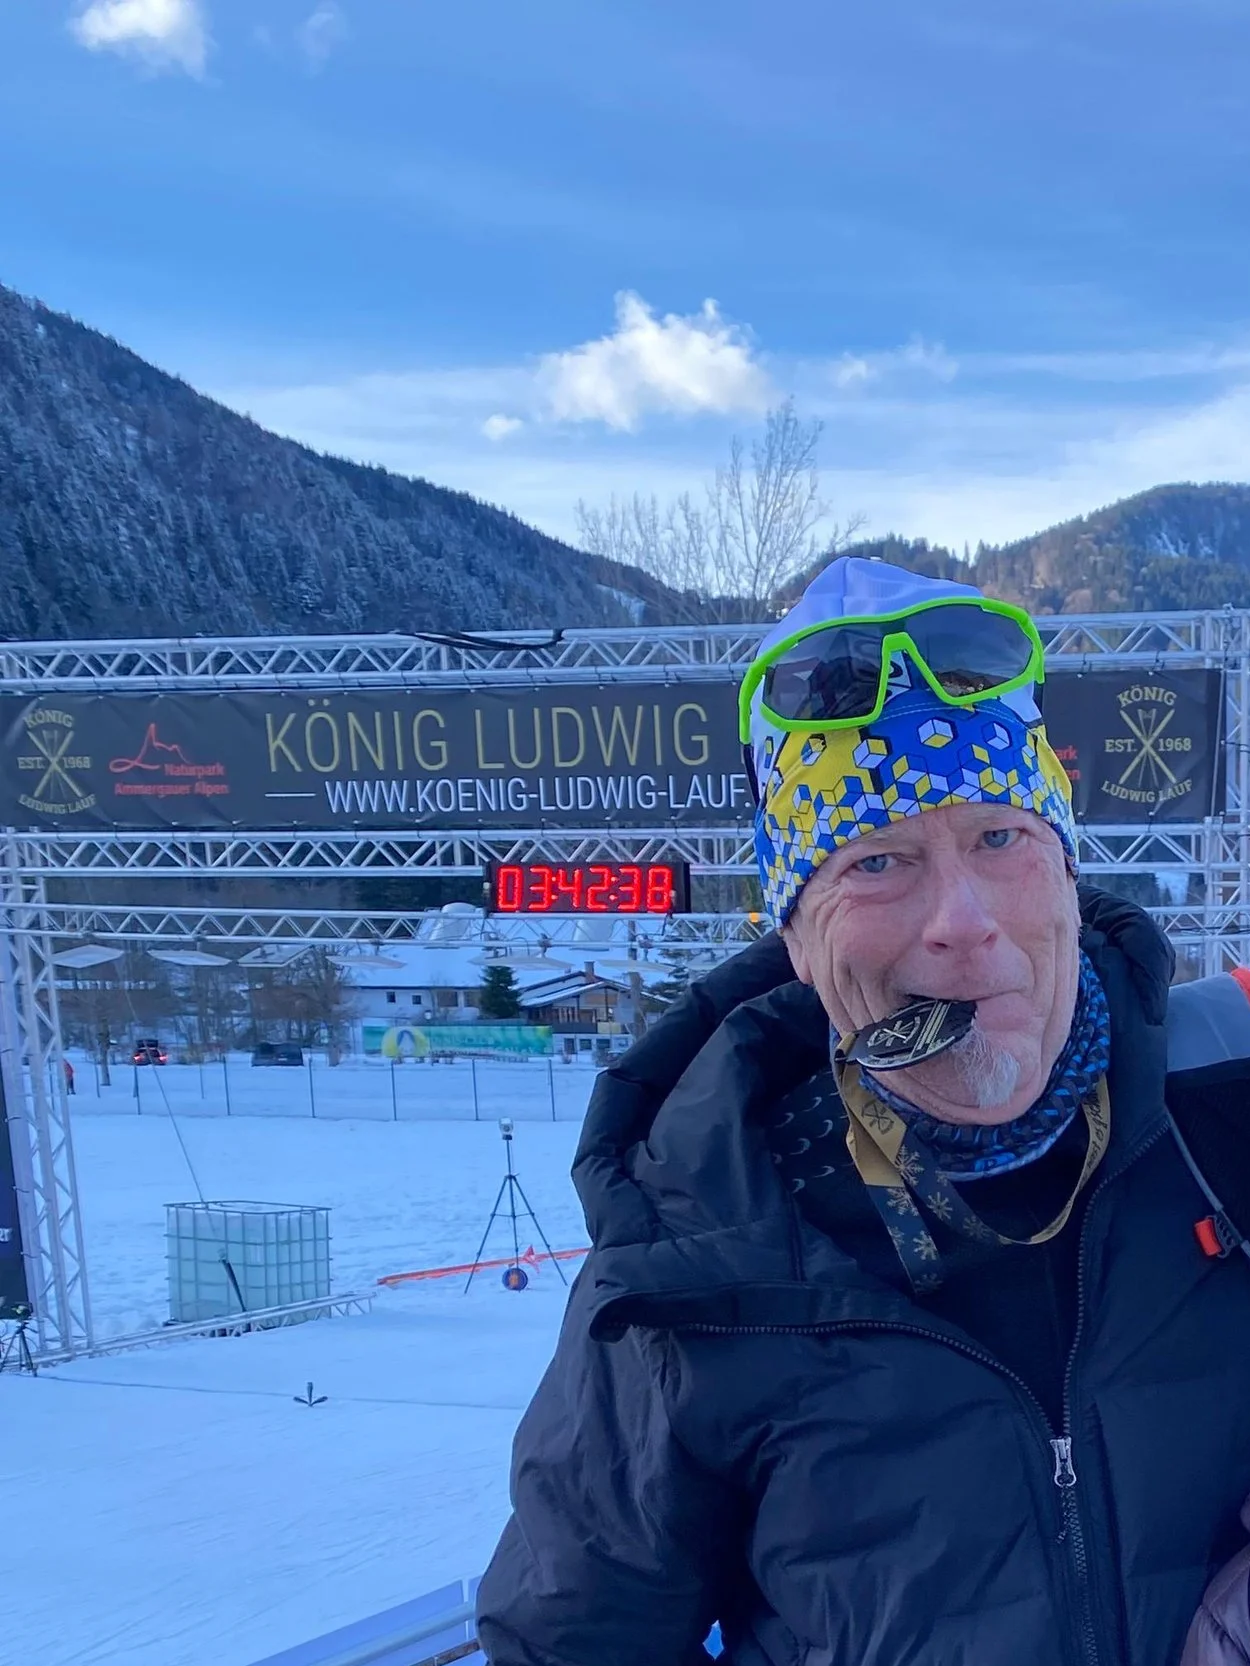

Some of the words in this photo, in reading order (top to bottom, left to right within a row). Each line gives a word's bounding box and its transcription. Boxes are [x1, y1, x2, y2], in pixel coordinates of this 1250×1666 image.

[1117, 685, 1177, 708] KÖNIG
[23, 708, 74, 728] KÖNIG
[265, 699, 448, 772] KÖNIG
[475, 703, 709, 769] LUDWIG
[1104, 739, 1138, 752] EST.
[1158, 738, 1192, 751] 1968
[17, 756, 45, 769] EST.
[63, 756, 91, 769] 1968
[164, 762, 225, 778] Naturpark
[114, 781, 191, 798] Ammergauer
[194, 781, 229, 797] Alpen
[325, 774, 752, 813] WWW.KOENIG-LUDWIG-LAUF.
[1101, 780, 1156, 803] LUDWIG
[1158, 779, 1193, 802] LAUF
[18, 793, 67, 814] LUDWIG
[66, 793, 97, 814] LAUF
[497, 865, 674, 912] 03:42:38
